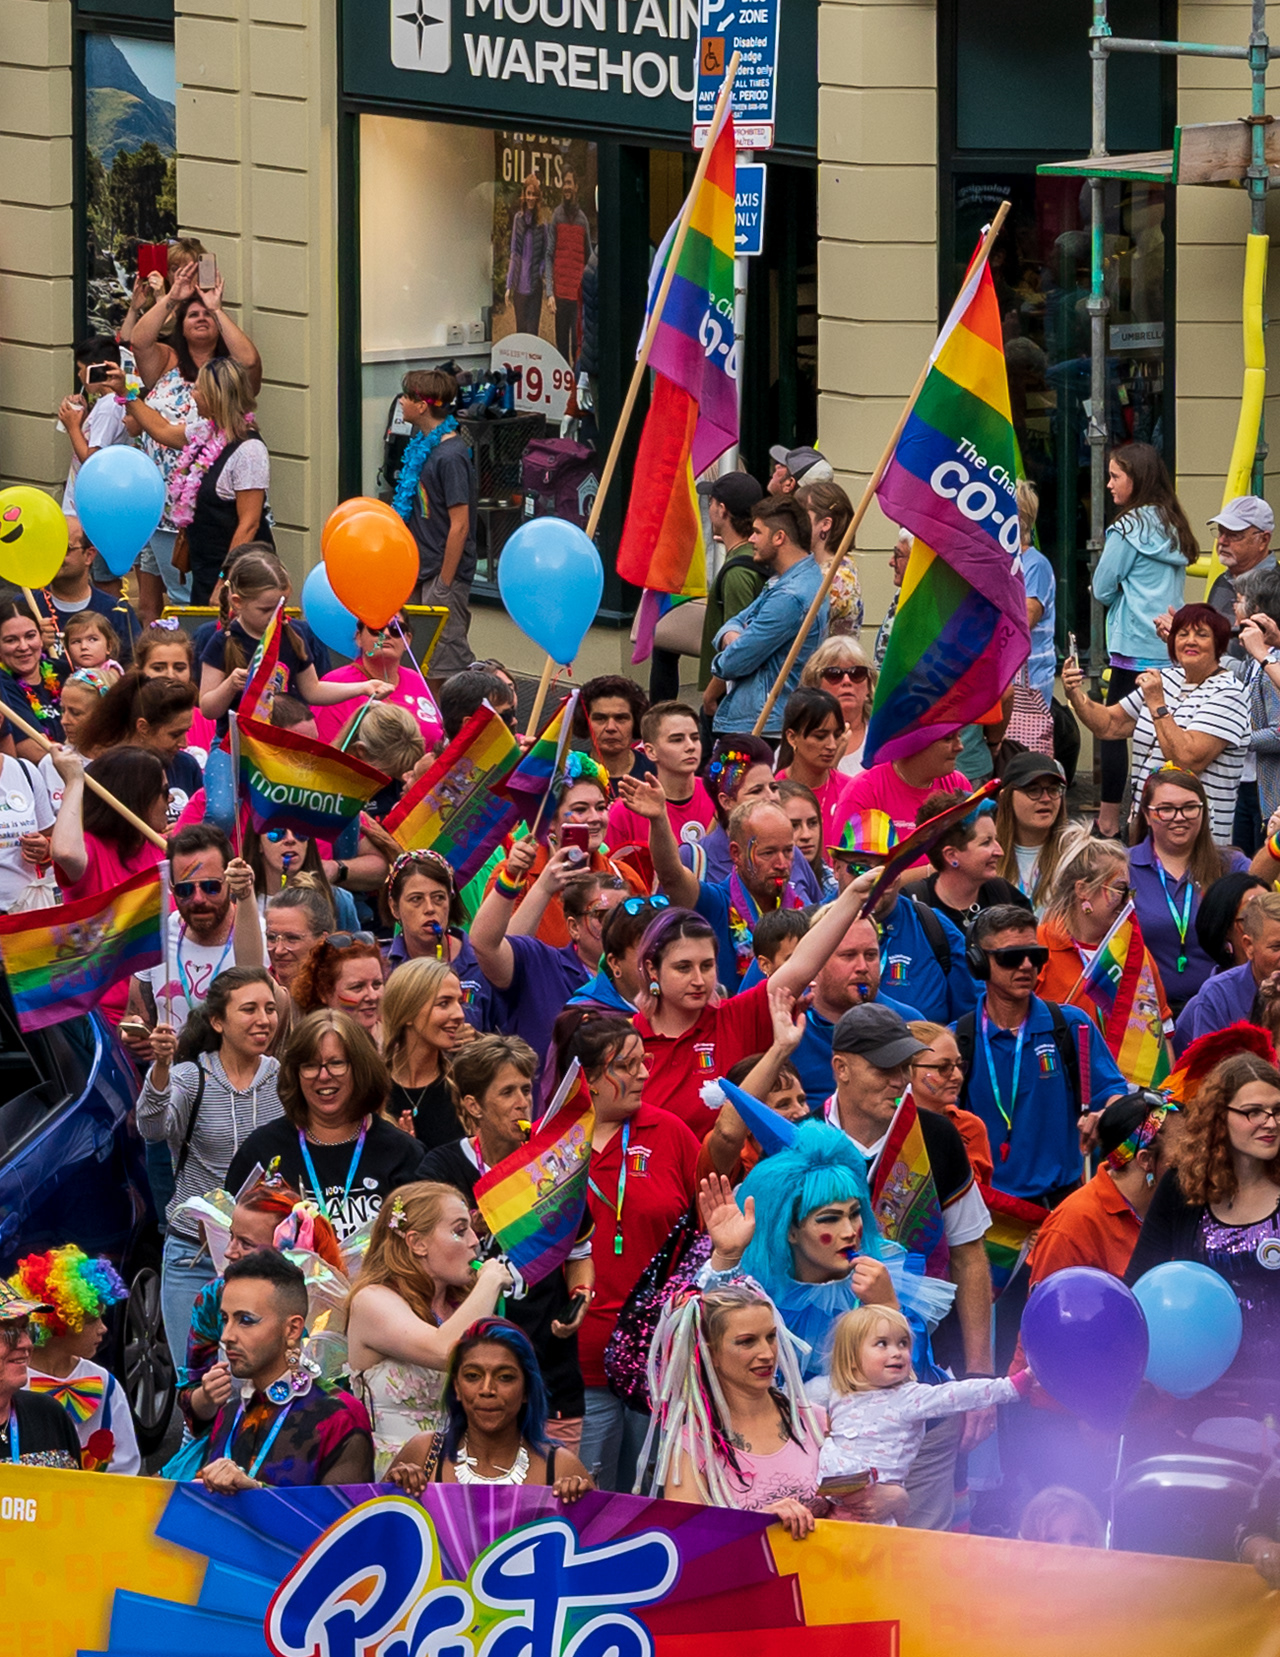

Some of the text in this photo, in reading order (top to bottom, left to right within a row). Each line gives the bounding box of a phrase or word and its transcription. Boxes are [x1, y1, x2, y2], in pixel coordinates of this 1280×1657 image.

[739, 9, 769, 24] ZONE
[733, 36, 768, 48] Disabled
[463, 33, 696, 101] WAREHOU
[756, 65, 774, 77] only
[735, 79, 770, 88] ALL TIMES
[698, 90, 768, 101] ANY PERIOD
[735, 193, 759, 207] AXIS
[735, 212, 758, 227] NLY
[955, 437, 988, 470] The
[249, 770, 344, 816] mourant
